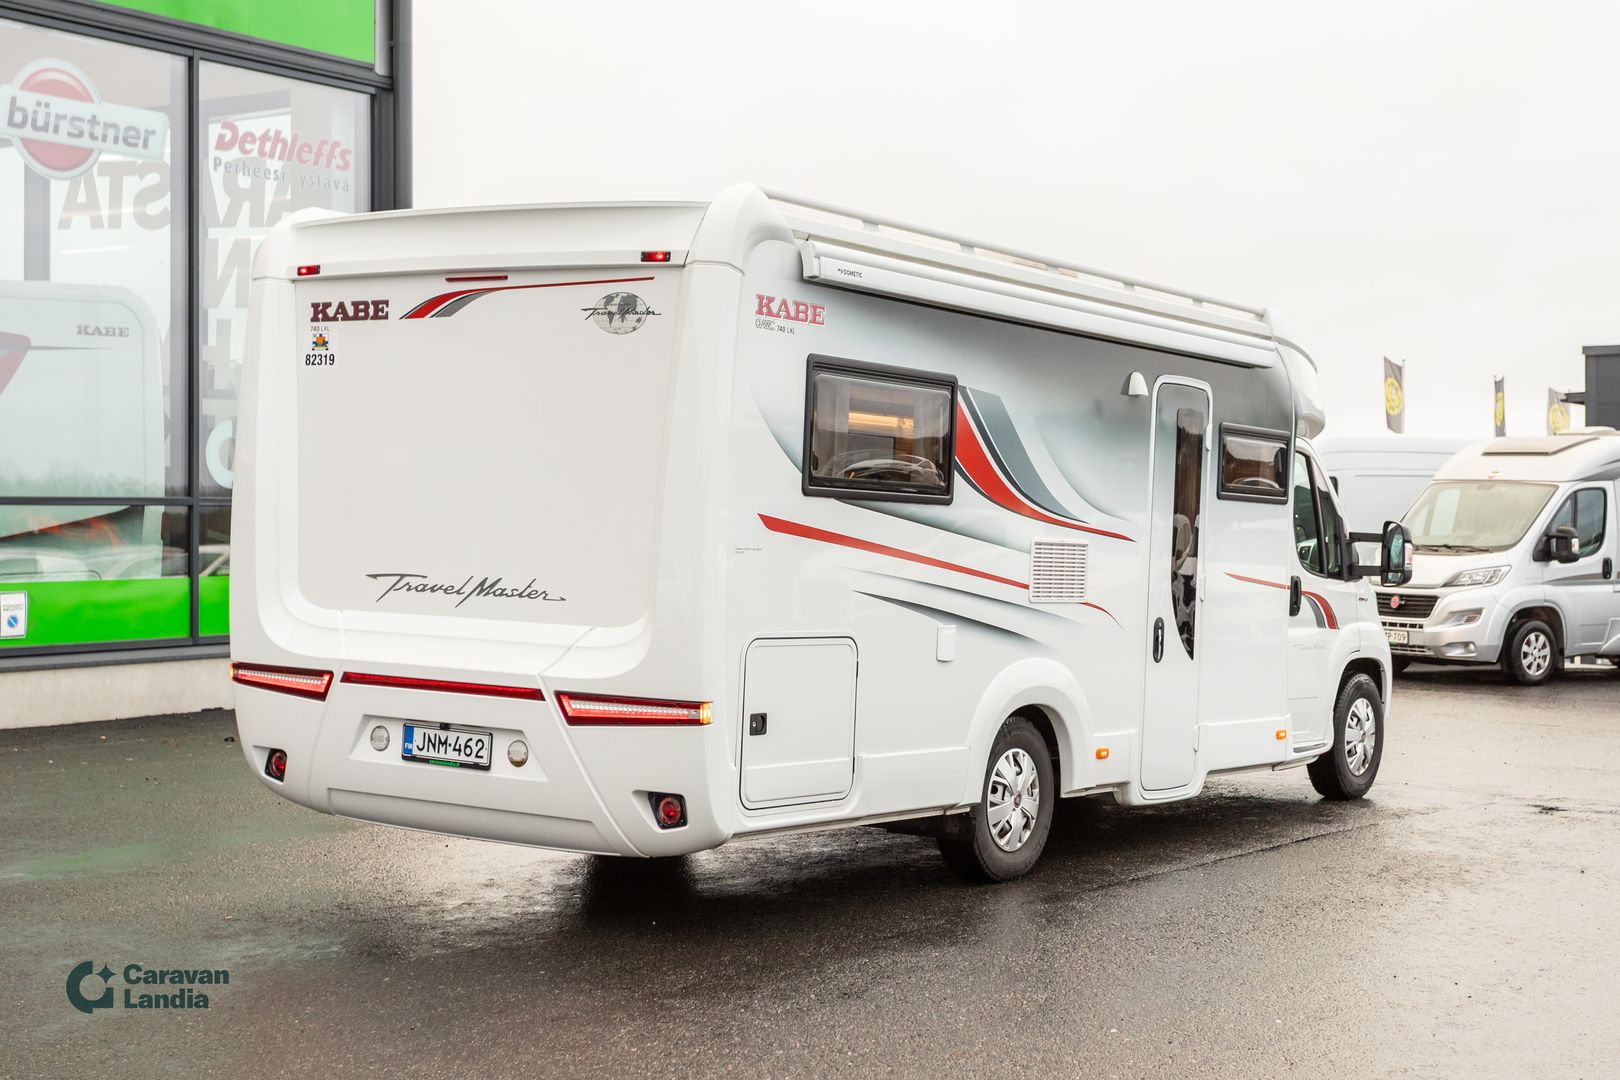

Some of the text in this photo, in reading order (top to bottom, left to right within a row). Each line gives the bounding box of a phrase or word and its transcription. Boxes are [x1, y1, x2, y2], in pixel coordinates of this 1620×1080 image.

[7, 95, 156, 150] bürstner
[214, 119, 352, 172] Dethleffs
[213, 156, 350, 192] Perheesi ystävä
[843, 268, 863, 279] DOMETIC
[310, 299, 389, 323] KABE
[755, 293, 826, 327] KABE
[76, 324, 130, 338] KABE
[777, 324, 786, 333] 740
[305, 353, 336, 366] 82319
[416, 731, 485, 759] JNM-462
